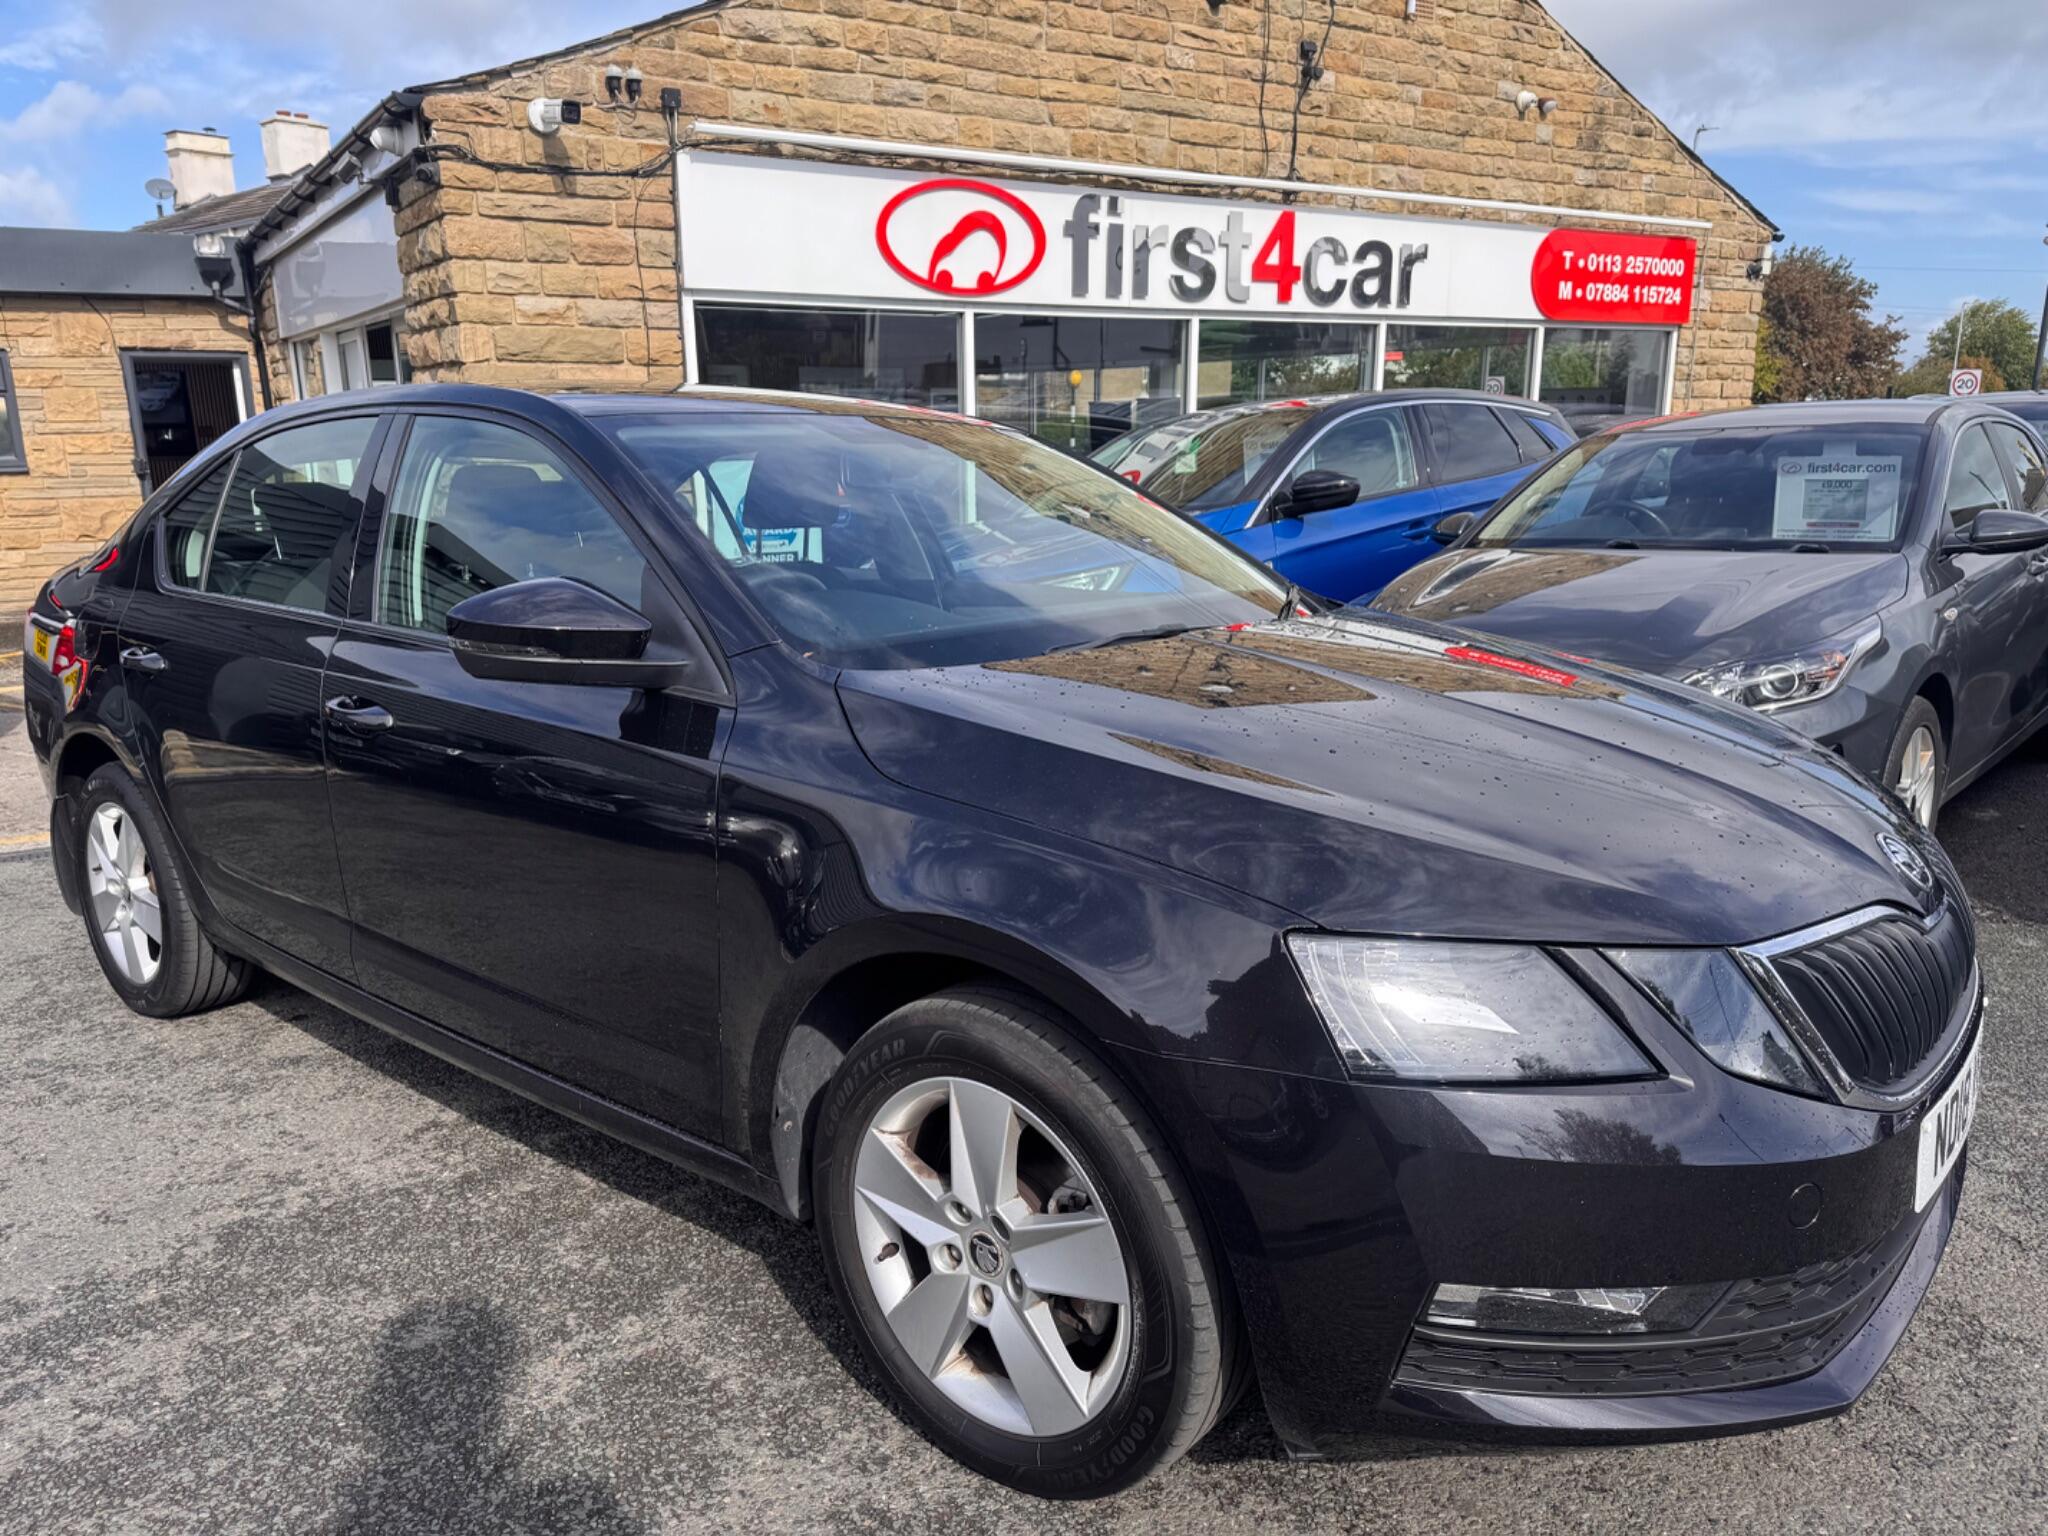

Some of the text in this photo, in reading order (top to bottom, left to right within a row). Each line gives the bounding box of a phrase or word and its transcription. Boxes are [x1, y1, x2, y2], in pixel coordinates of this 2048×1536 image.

[1063, 193, 1429, 308] first4car
[1587, 253, 1622, 273] 0113
[1625, 255, 1685, 277] 2570000
[1585, 282, 1629, 302] 07884
[1633, 285, 1682, 304] 115724
[1957, 378, 1974, 389] 20
[1806, 462, 1897, 474] first4car.com
